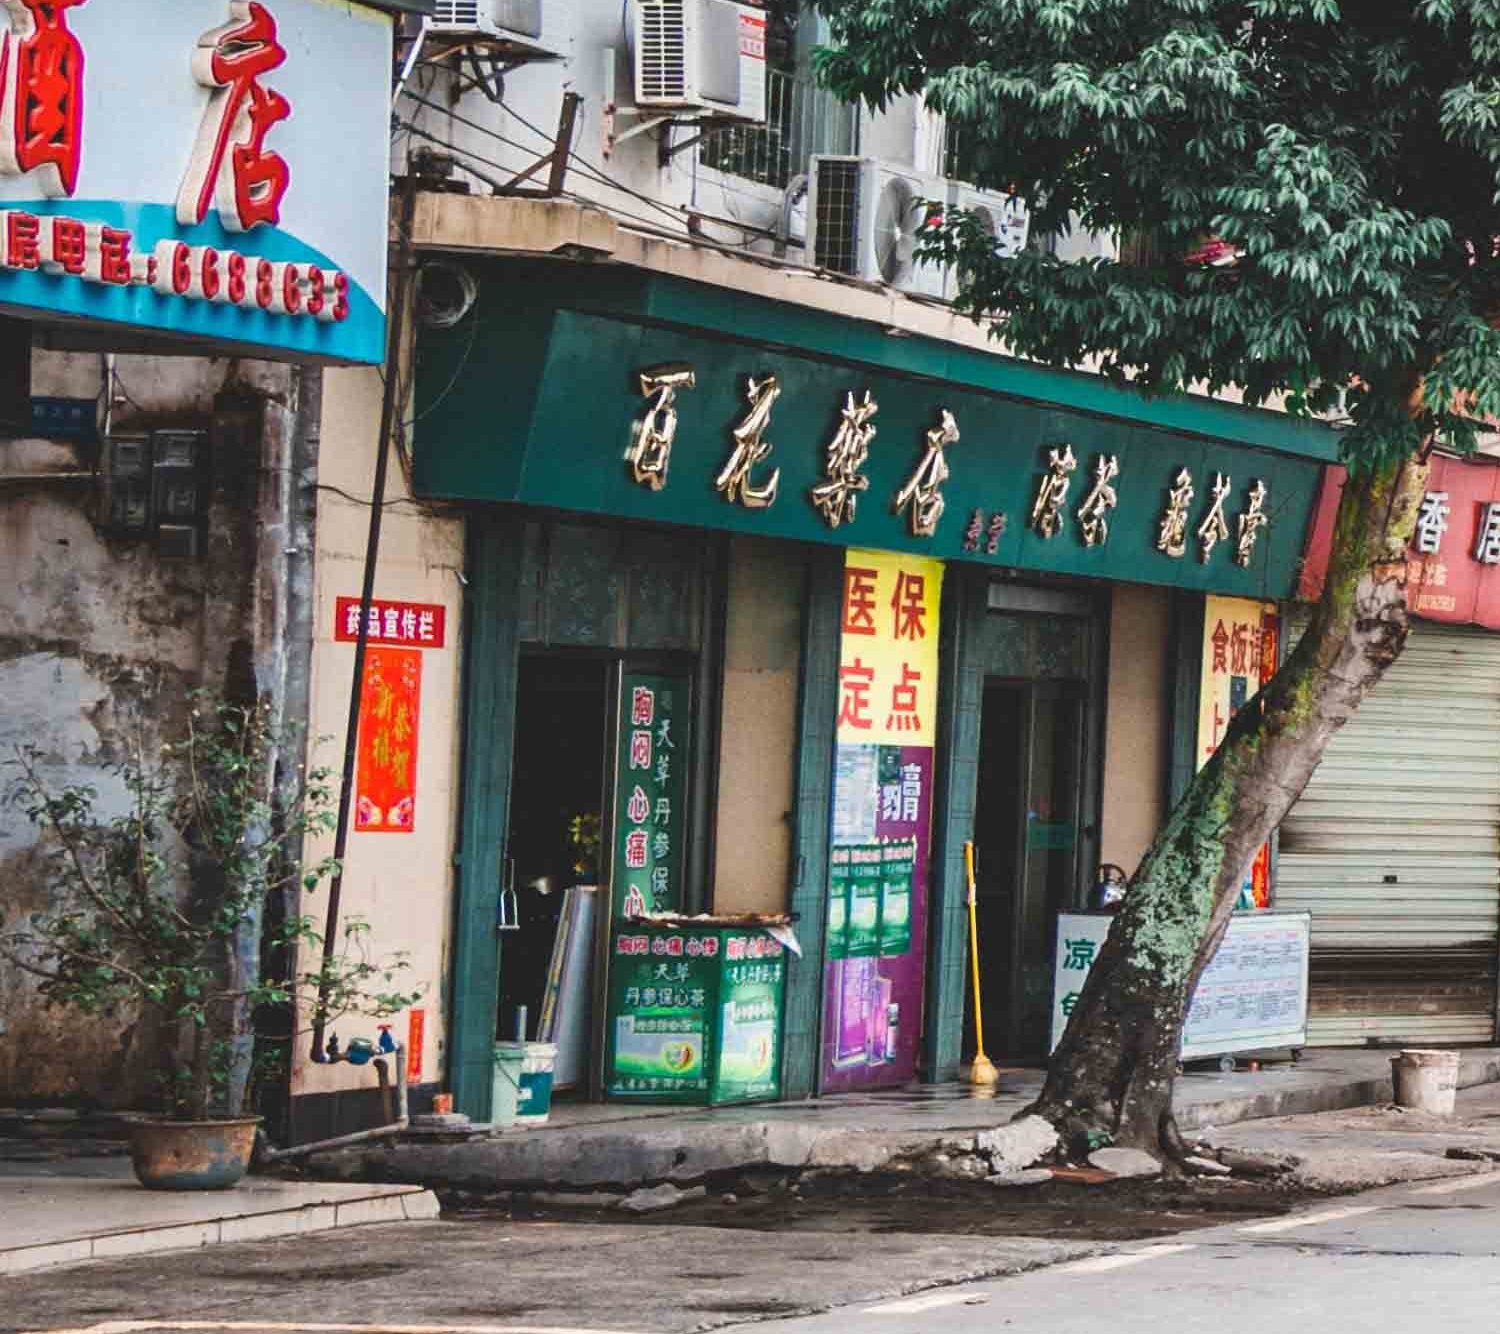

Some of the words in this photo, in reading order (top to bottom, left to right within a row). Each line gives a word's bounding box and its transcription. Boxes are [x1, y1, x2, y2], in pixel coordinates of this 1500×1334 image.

[346, 605, 434, 640] 药品宣传栏
[842, 567, 927, 641] 医保
[837, 658, 922, 732] 定点
